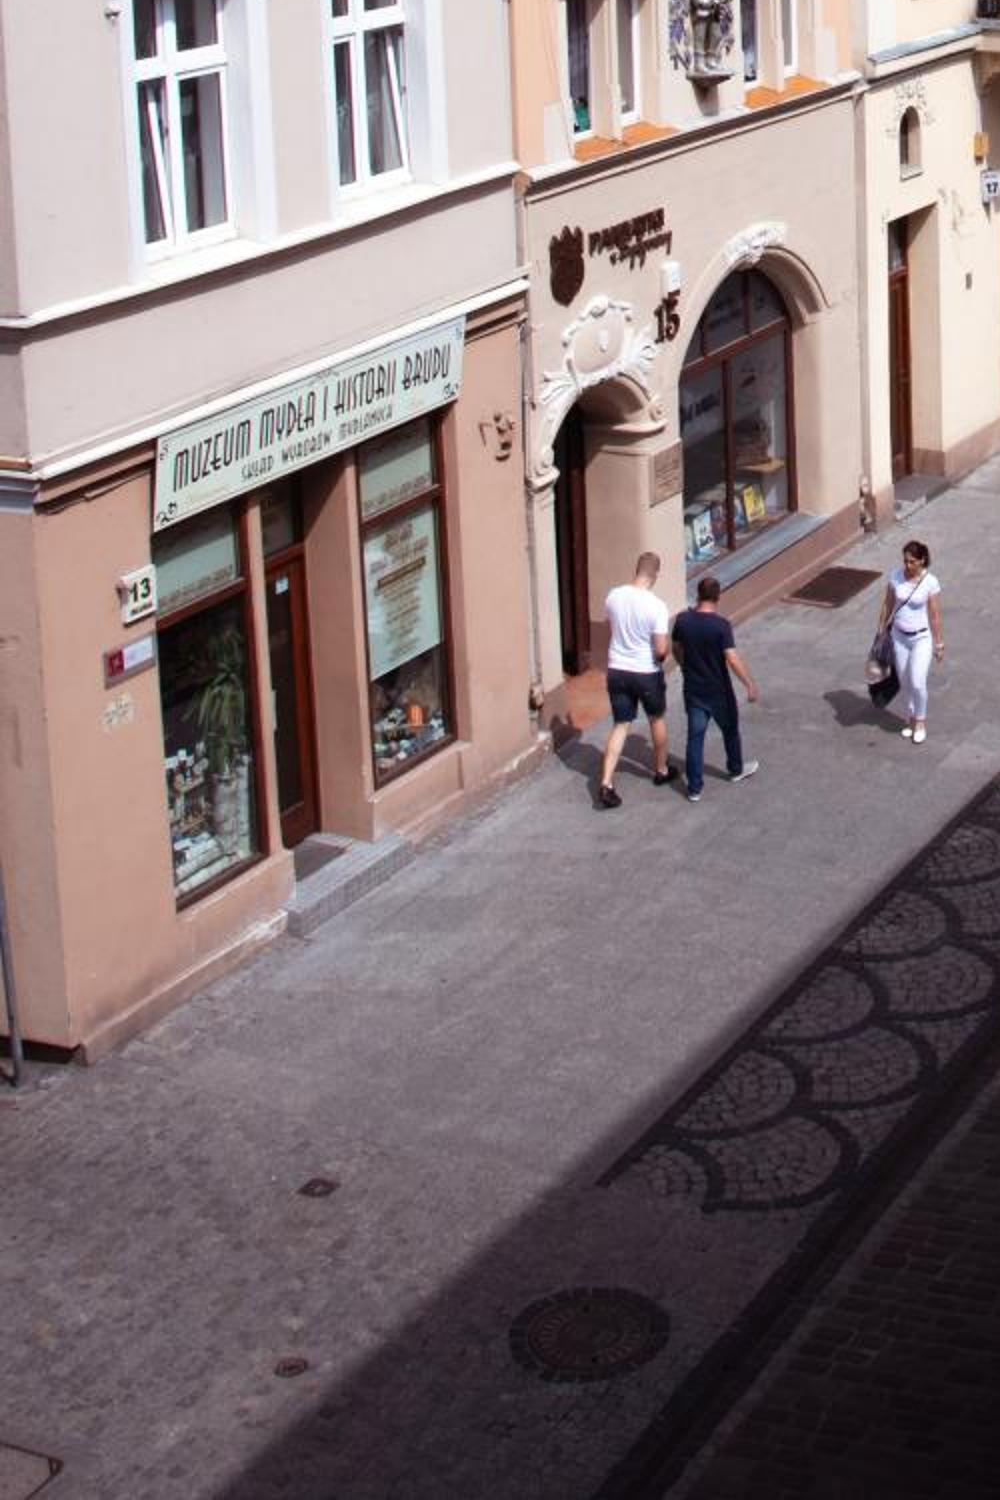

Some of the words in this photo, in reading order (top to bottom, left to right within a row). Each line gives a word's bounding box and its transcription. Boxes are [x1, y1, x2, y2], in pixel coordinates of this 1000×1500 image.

[654, 289, 681, 344] 15
[173, 419, 252, 492] MUZEUM
[259, 391, 316, 450] MYDŁA
[323, 385, 328, 421] I
[333, 359, 397, 416] HISTORII
[402, 343, 451, 390] BRUDU
[129, 577, 151, 603] 13
